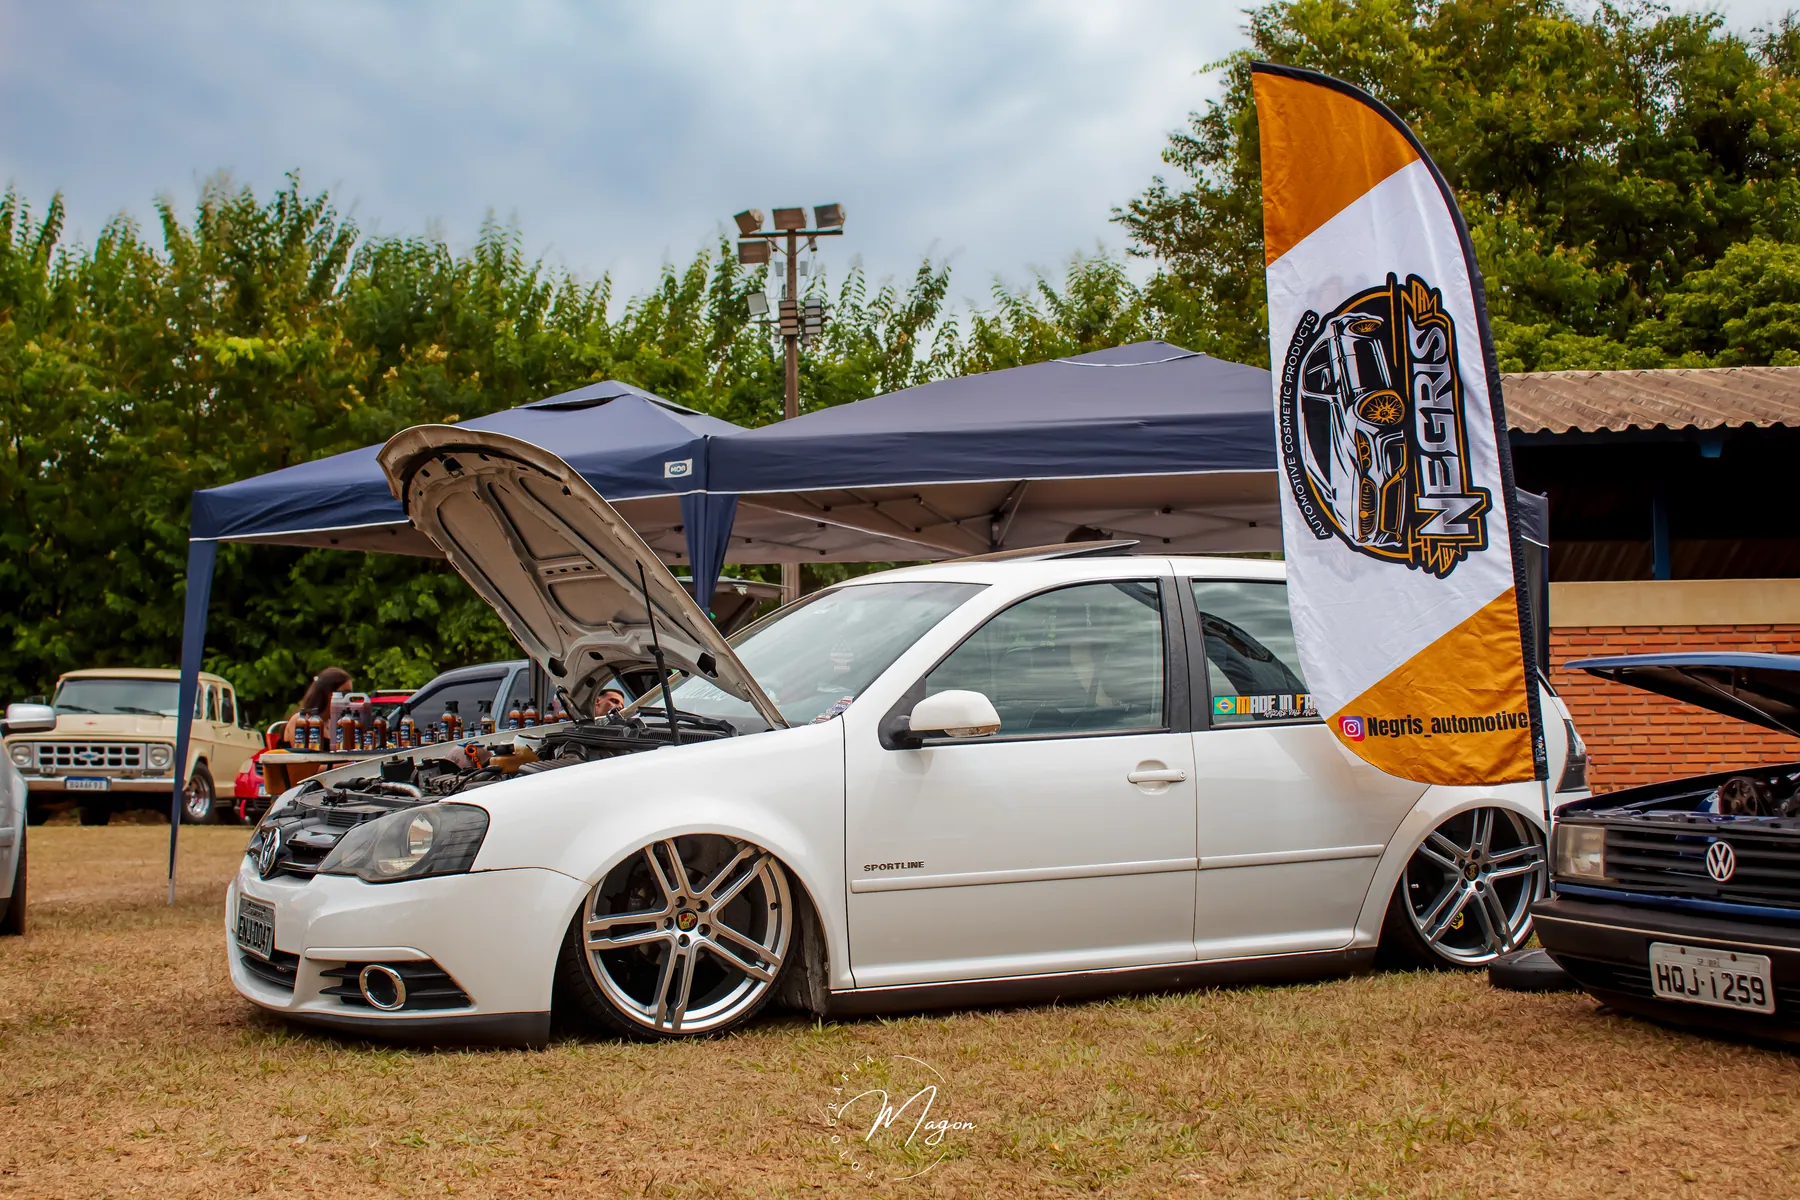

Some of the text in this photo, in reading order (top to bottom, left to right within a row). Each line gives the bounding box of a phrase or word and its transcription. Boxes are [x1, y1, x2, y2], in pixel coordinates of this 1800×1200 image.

[1282, 314, 1329, 536] AUTOMOTIVE COSMETIC PRODUCTS
[1408, 315, 1482, 535] NEGRIS
[1368, 710, 1528, 738] Negris_automotive
[863, 861, 924, 872] SPORTLINE
